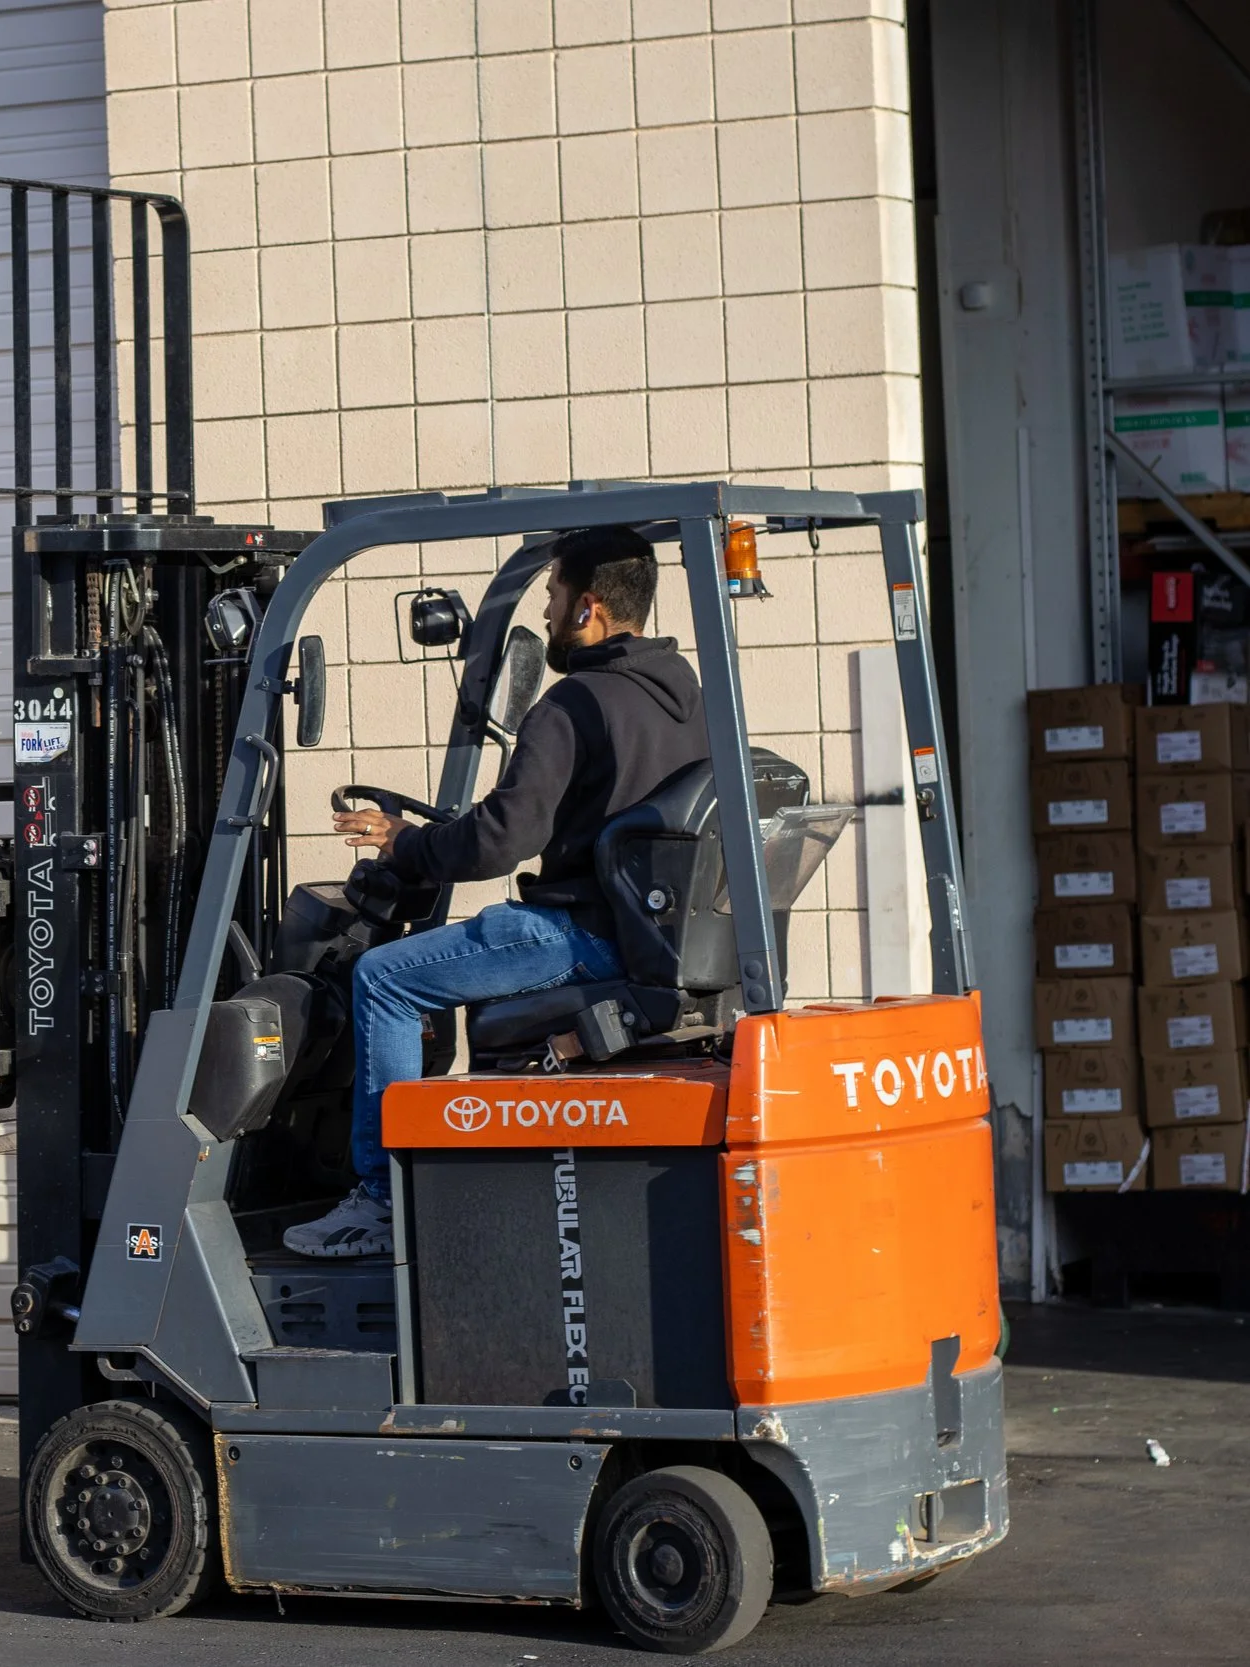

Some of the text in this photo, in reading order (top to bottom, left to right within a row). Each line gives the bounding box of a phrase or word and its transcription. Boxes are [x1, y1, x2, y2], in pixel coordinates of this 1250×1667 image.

[14, 699, 73, 720] 3044
[21, 730, 43, 751] FORK
[43, 736, 61, 748] LIFT
[28, 857, 55, 1035] TOYOTA
[831, 1046, 988, 1107] TOYOTA
[496, 1100, 629, 1127] TOYOTA
[553, 1147, 583, 1280] TUBULAR
[563, 1290, 588, 1359] FLEX
